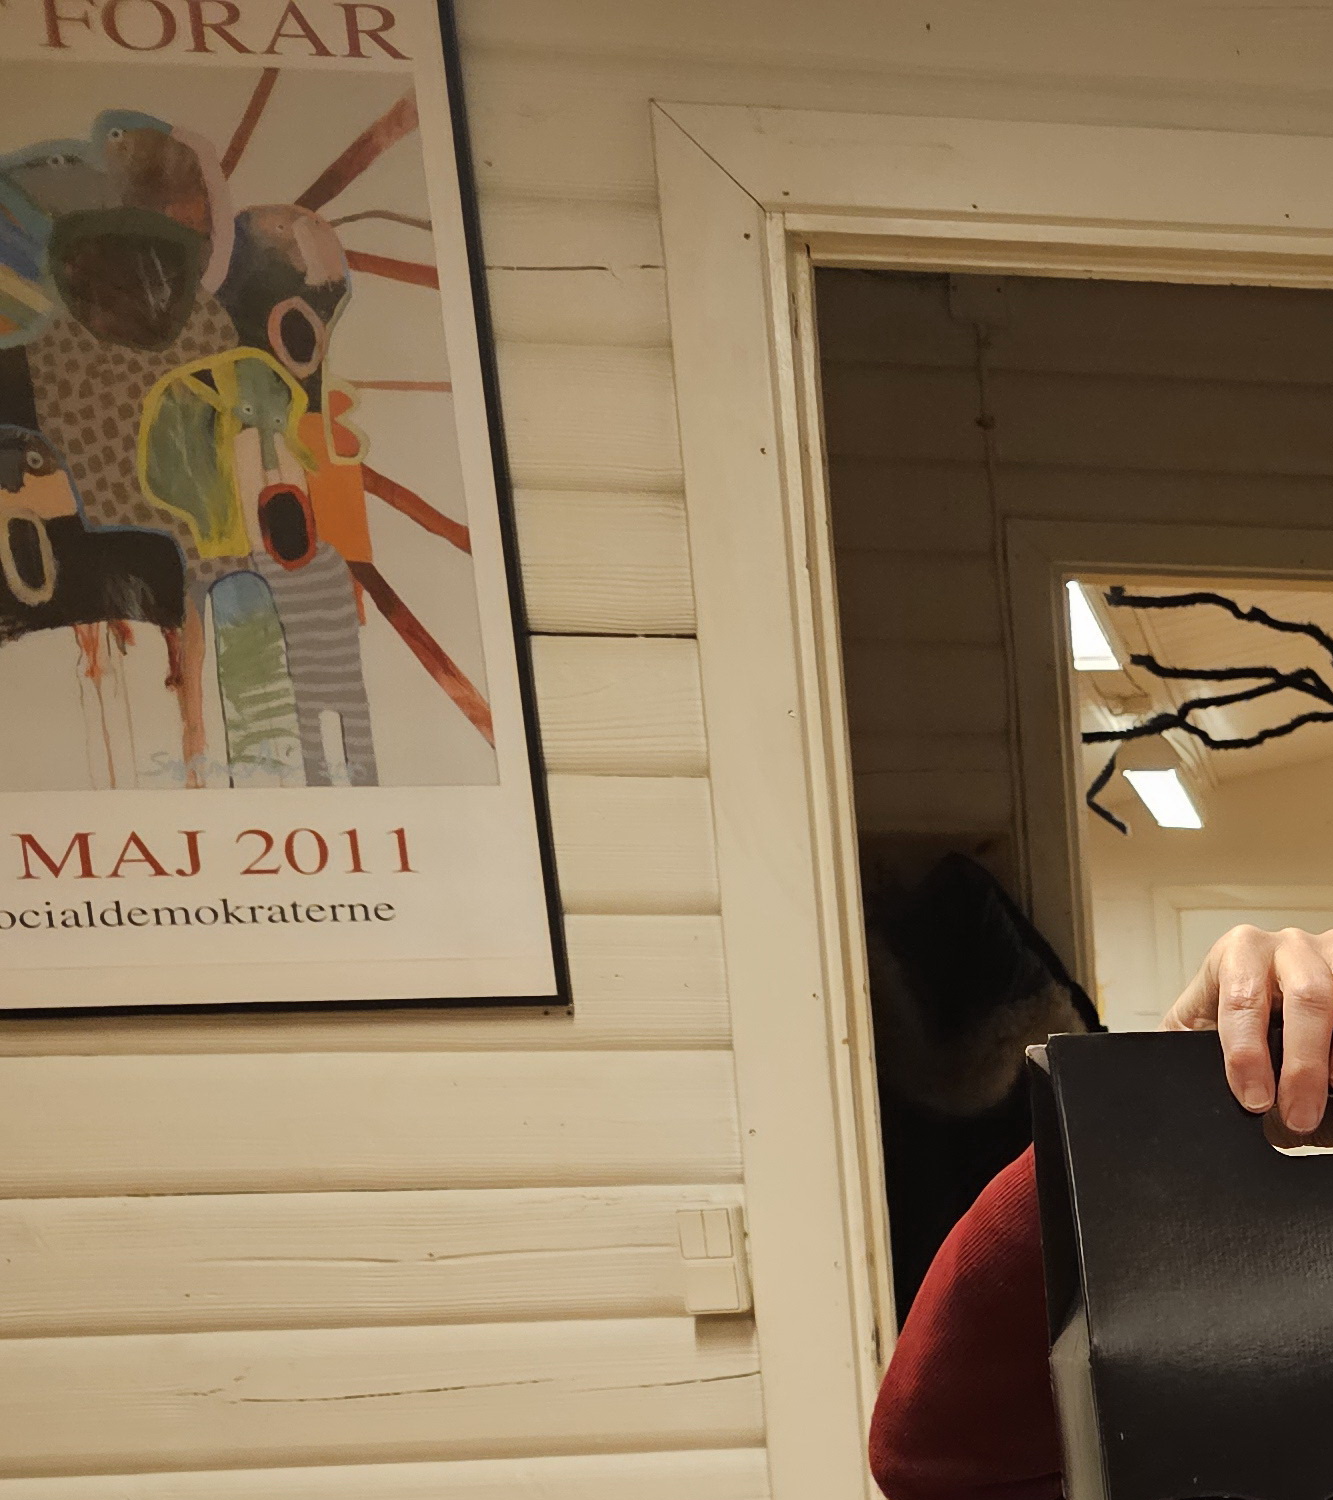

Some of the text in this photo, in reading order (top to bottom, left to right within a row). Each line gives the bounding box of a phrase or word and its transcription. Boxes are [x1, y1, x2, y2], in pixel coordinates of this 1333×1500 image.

[12, 827, 420, 880] MAJ 2011
[0, 898, 397, 930] ocialdemokraterne
